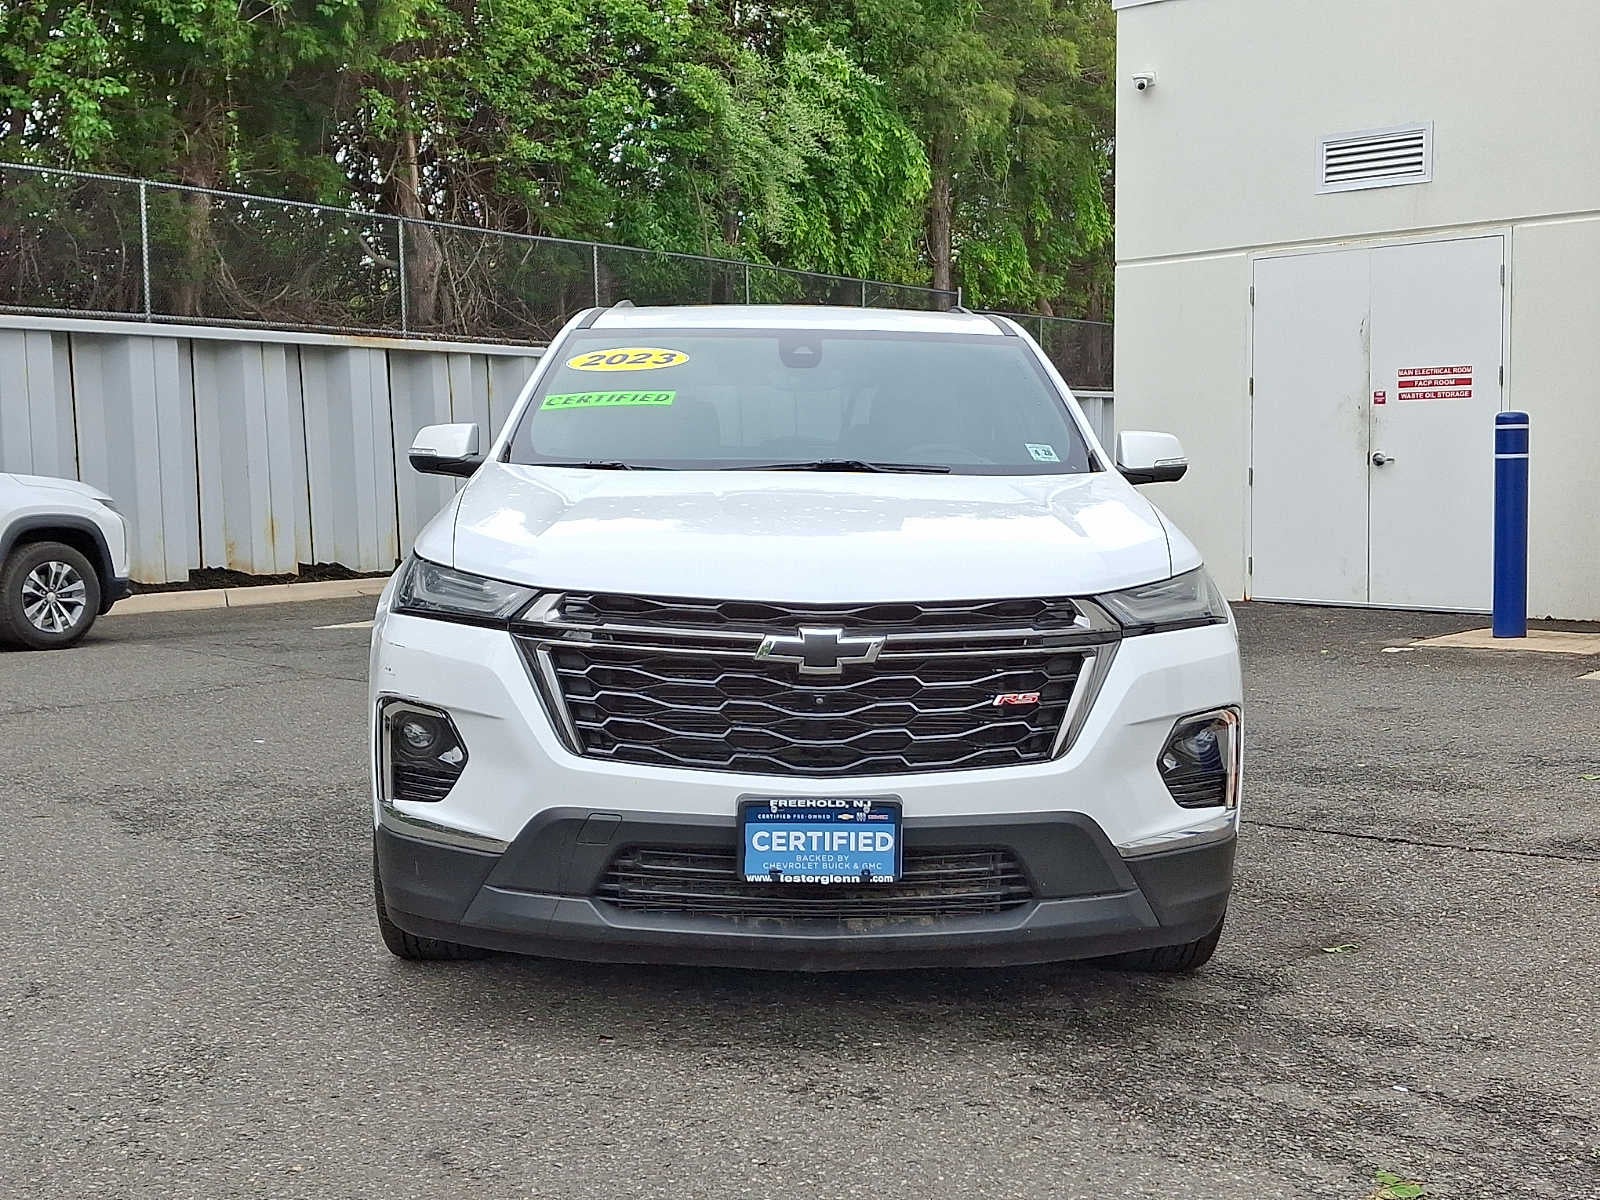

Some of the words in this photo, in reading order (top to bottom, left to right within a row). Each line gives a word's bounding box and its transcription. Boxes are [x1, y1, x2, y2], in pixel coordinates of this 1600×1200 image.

[580, 353, 676, 367] 2023
[1415, 367, 1452, 376] ELECTRICAL
[1453, 366, 1472, 374] ROOM
[545, 393, 671, 406] CERTIFIED
[1425, 391, 1436, 399] OIL
[1437, 390, 1470, 398] STORAGE
[993, 692, 1040, 706] RS
[752, 831, 895, 852] CERTIFIED
[796, 854, 834, 862] BACKED
[838, 854, 849, 862] BY
[763, 862, 819, 870] CHEVROLET
[822, 862, 850, 870] BUICK
[862, 862, 882, 870] GMC
